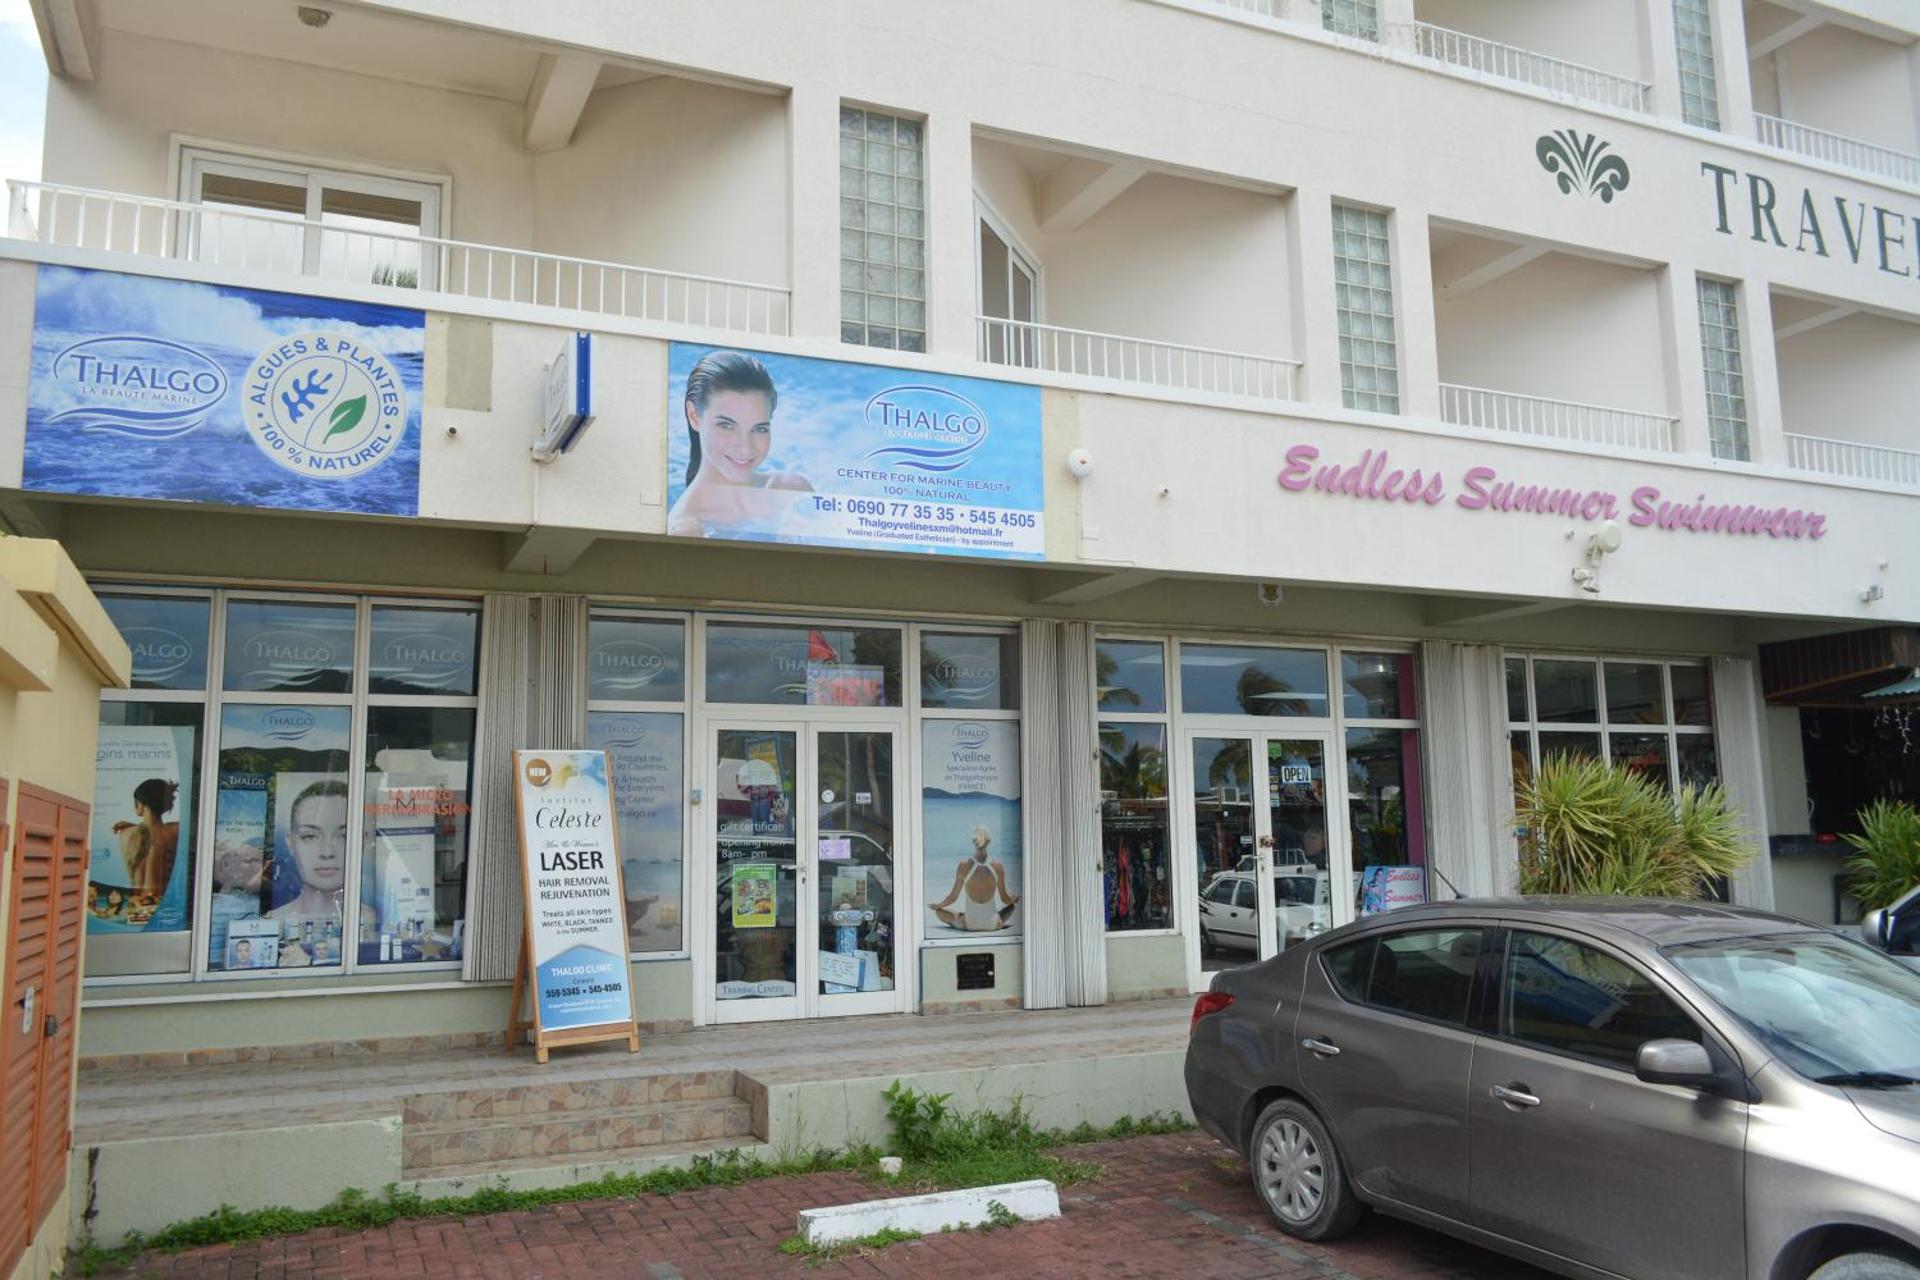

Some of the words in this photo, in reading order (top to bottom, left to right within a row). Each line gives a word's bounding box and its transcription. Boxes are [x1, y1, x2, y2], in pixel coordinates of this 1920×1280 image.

[70, 354, 219, 394] THALGO
[251, 340, 307, 406] ALGUES
[315, 337, 329, 351] &
[337, 340, 399, 417] PLANTES
[152, 393, 197, 404] MARINE
[876, 401, 981, 435] THALGO
[260, 423, 285, 450] 100
[308, 435, 392, 470] NATUREL
[836, 468, 887, 482] CENTER
[890, 473, 916, 484] FOR
[918, 475, 963, 489] MARINE
[967, 480, 1012, 492] BEAUTY
[883, 485, 912, 496] 100%
[915, 488, 971, 502] NATURAL
[1278, 444, 1446, 505] Endless
[1456, 467, 1619, 520] Summer
[1628, 486, 1828, 540] Swimwear
[812, 496, 842, 513] Tel:
[847, 499, 885, 516] 0690
[890, 502, 908, 517] 77
[914, 504, 932, 520] 35
[937, 507, 955, 522] 35
[969, 510, 996, 525] 545
[1001, 512, 1036, 529] 4505
[254, 641, 330, 662] THALGO
[391, 645, 465, 663] THALGO
[597, 651, 662, 668] THALGO
[942, 663, 994, 678] THALGO
[269, 716, 314, 727] THALGO
[957, 728, 988, 738] THALGO
[952, 751, 991, 763] Yveline
[228, 775, 266, 786] THALGO
[529, 767, 547, 777] NEW
[1283, 767, 1309, 782] OPEN
[535, 807, 602, 829] Celeste
[540, 850, 604, 871] LASER
[538, 878, 562, 888] HAIR
[564, 875, 609, 887] REMOVAL
[540, 888, 611, 900] REJUVENATION
[577, 908, 591, 916] skin
[592, 907, 612, 917] types
[552, 966, 585, 977] THALGO
[586, 963, 613, 974] CLINIC
